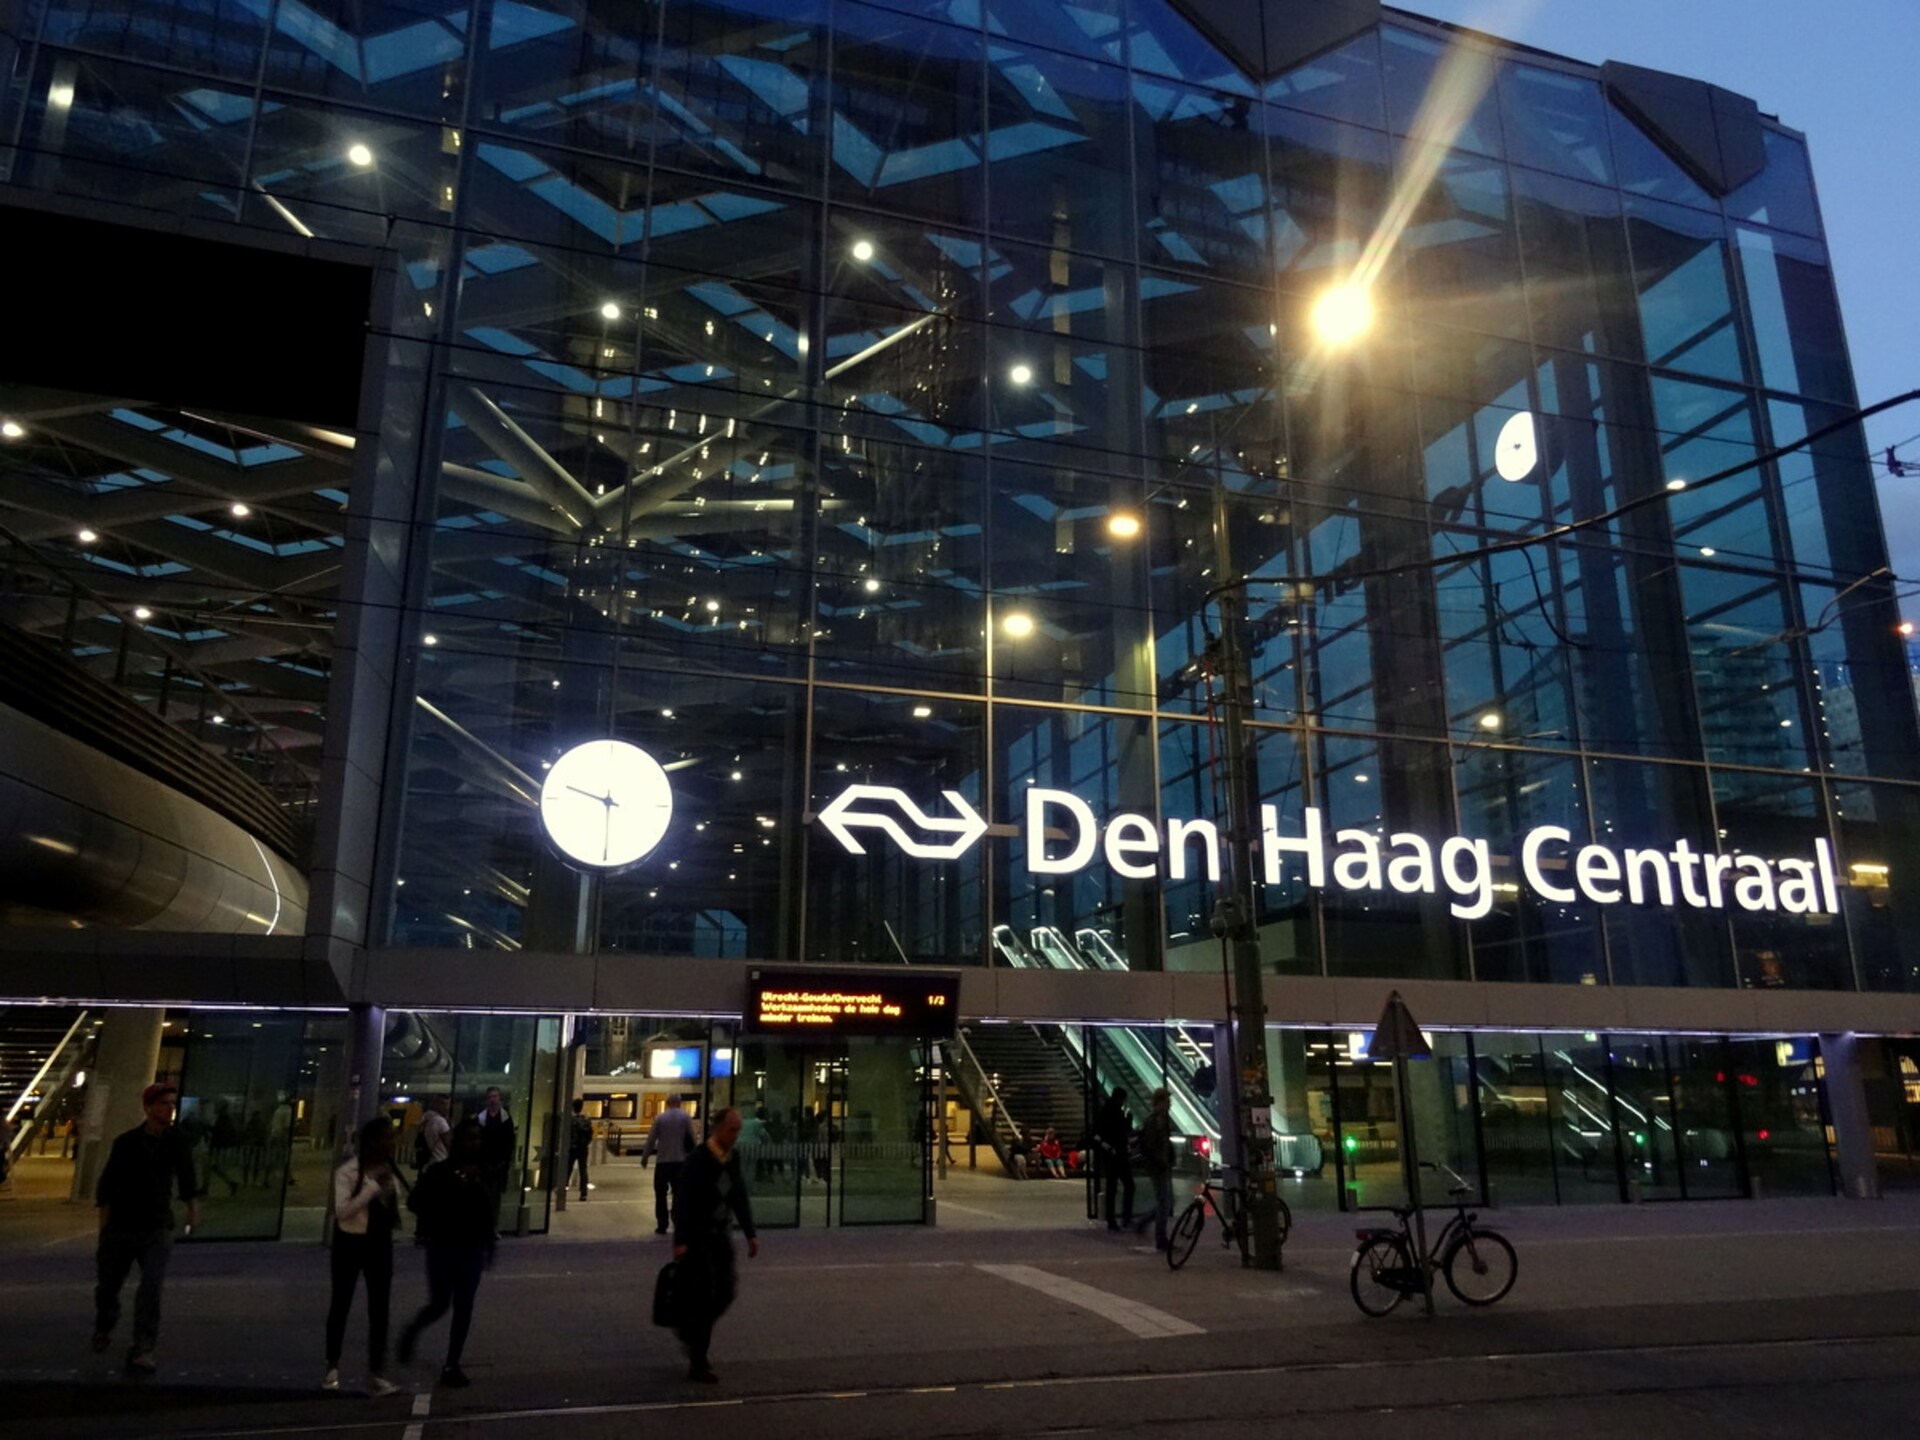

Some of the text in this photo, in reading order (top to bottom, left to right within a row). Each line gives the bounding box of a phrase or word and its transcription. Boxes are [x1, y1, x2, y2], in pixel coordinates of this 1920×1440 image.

[1026, 787, 1840, 920] Den Haag Centraal
[928, 995, 945, 1005] 1/2
[844, 1004, 856, 1013] de
[882, 1004, 901, 1016] dag
